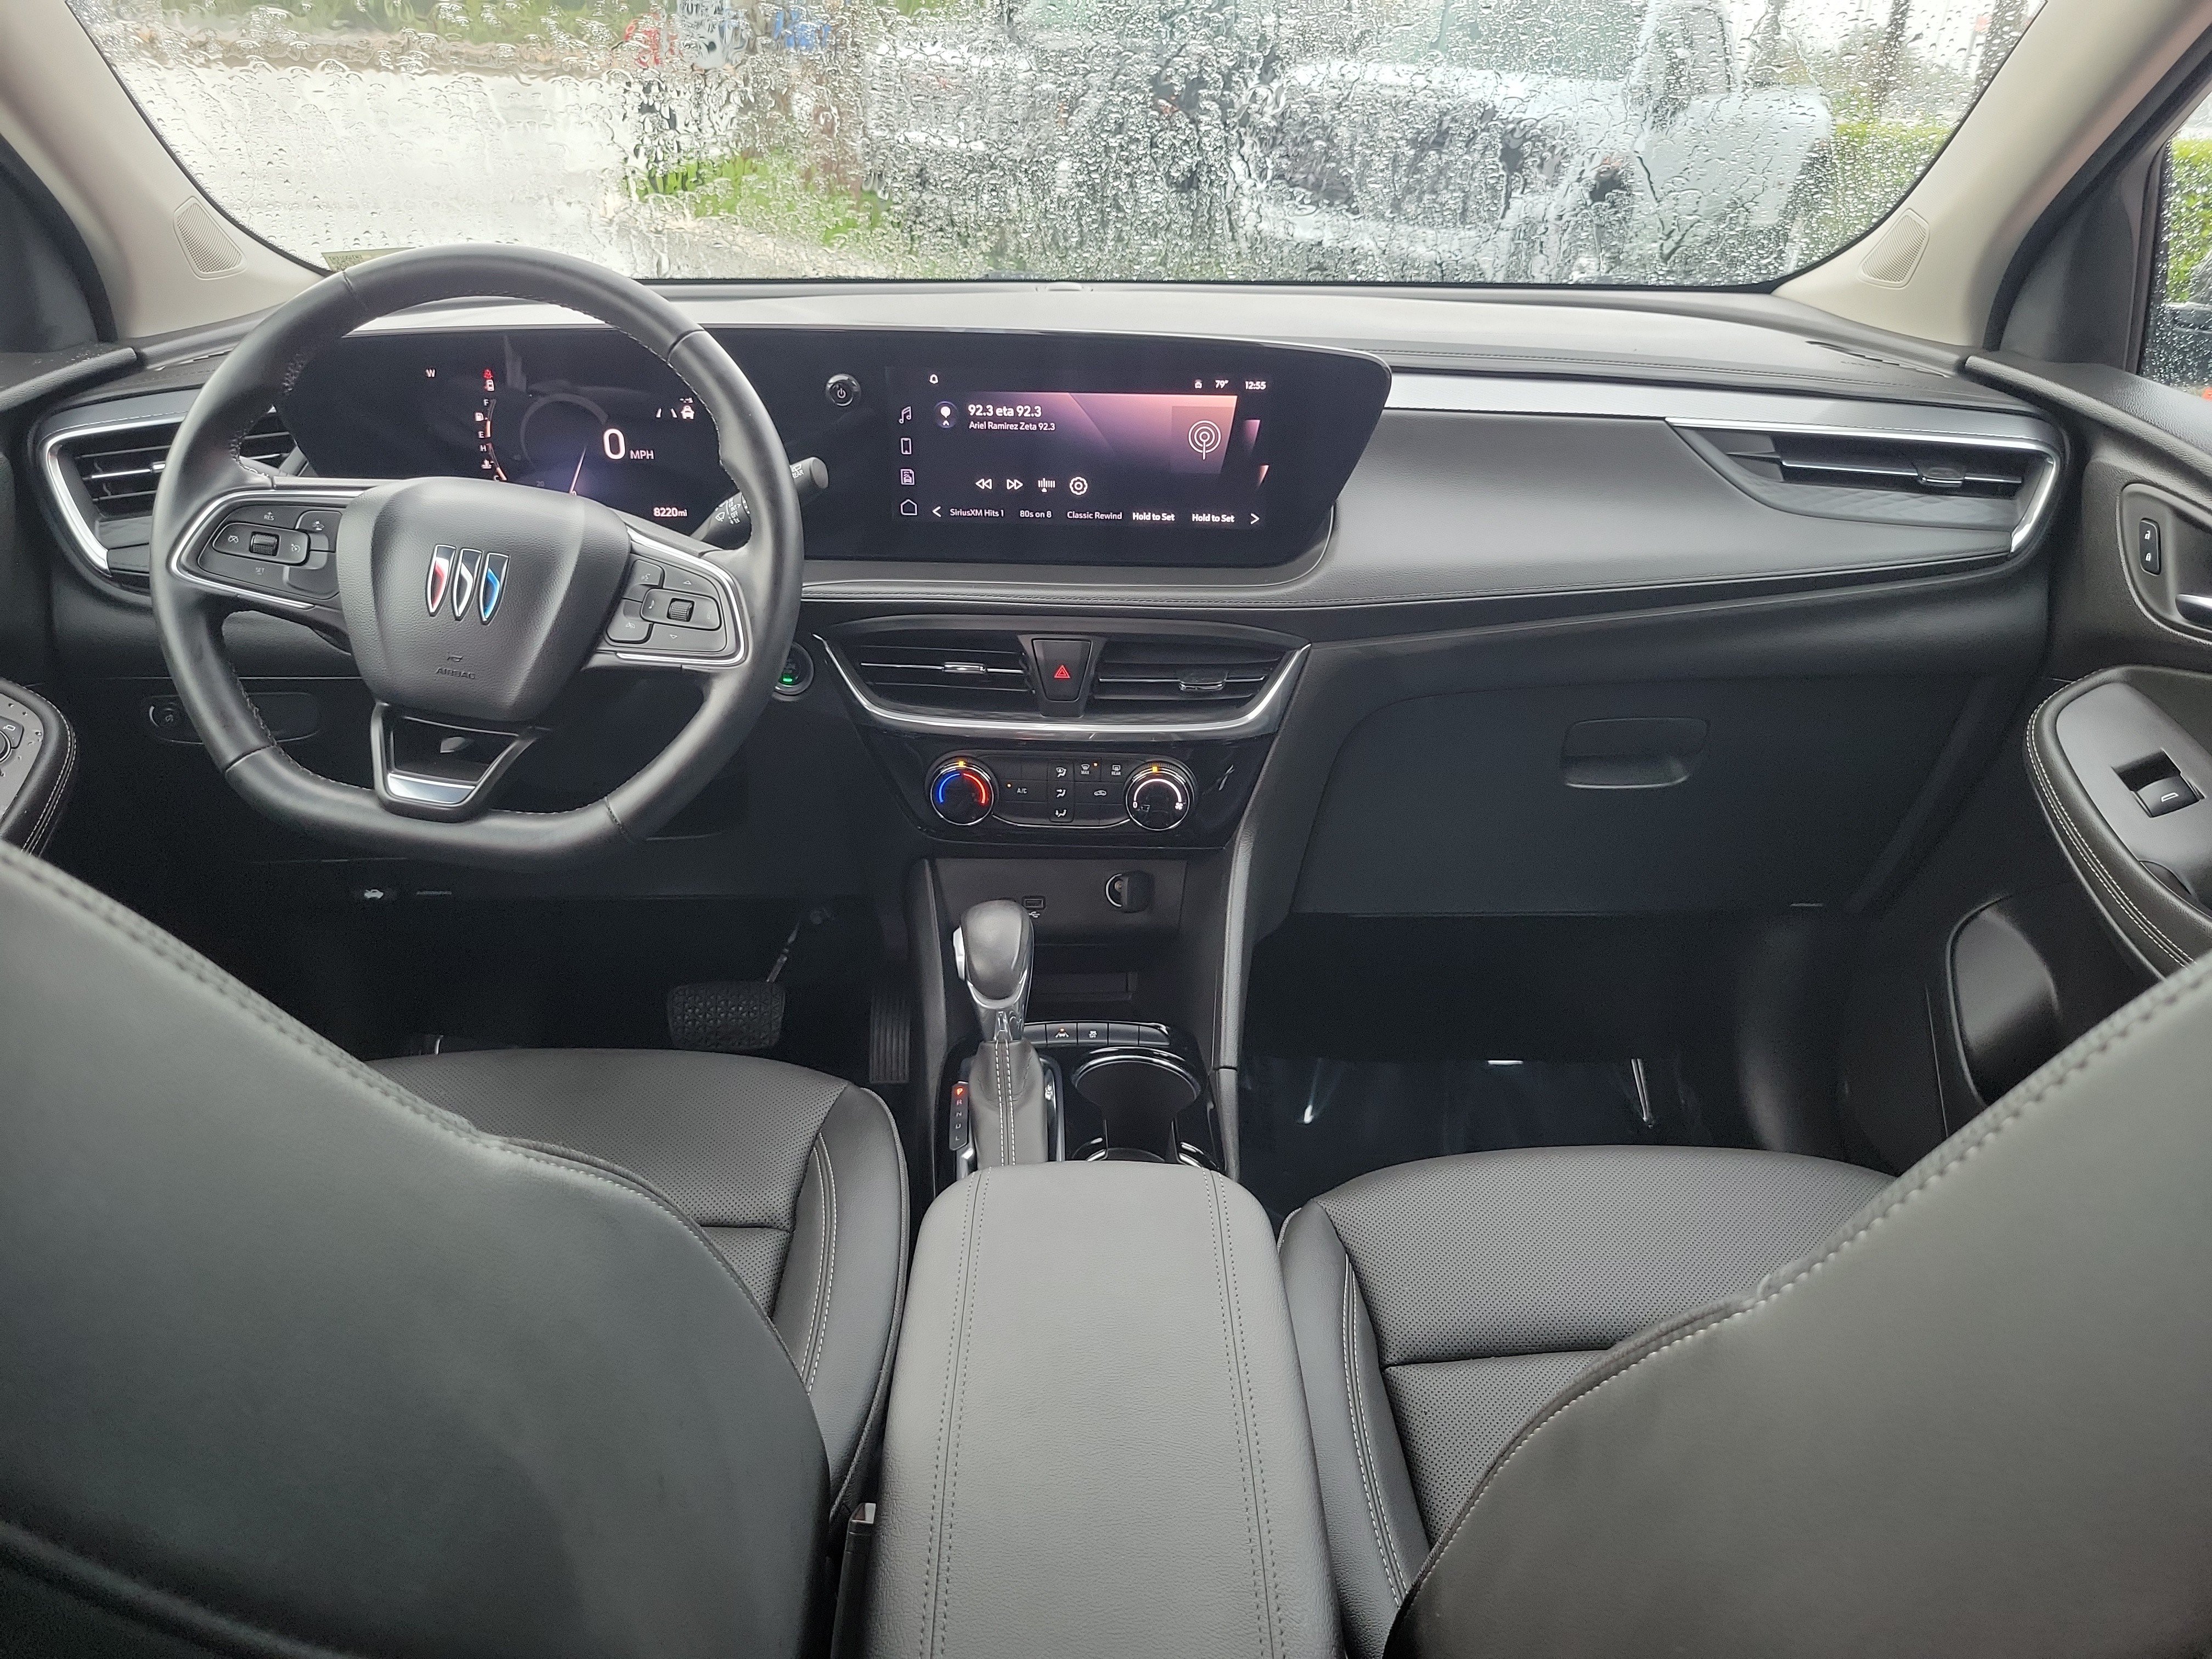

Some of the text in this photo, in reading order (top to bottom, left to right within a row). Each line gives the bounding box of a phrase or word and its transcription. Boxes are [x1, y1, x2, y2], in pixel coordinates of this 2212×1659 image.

[426, 369, 435, 377] W
[1245, 381, 1266, 390] 12:55
[968, 404, 1042, 417] 92.3 eta 92.3
[969, 421, 986, 430] Ariel
[1019, 422, 1037, 431] Zeta
[1038, 422, 1056, 431] 92.3
[629, 449, 654, 460] MPH
[792, 469, 804, 478] REAR
[950, 508, 983, 516] SiriusXM
[1001, 509, 1004, 517] 1
[1067, 511, 1122, 520] Classic Rewind
[1132, 512, 1151, 521] Hold
[1192, 514, 1211, 522] Hold
[1221, 514, 1235, 522] Set
[436, 667, 476, 680] AIRBAG
